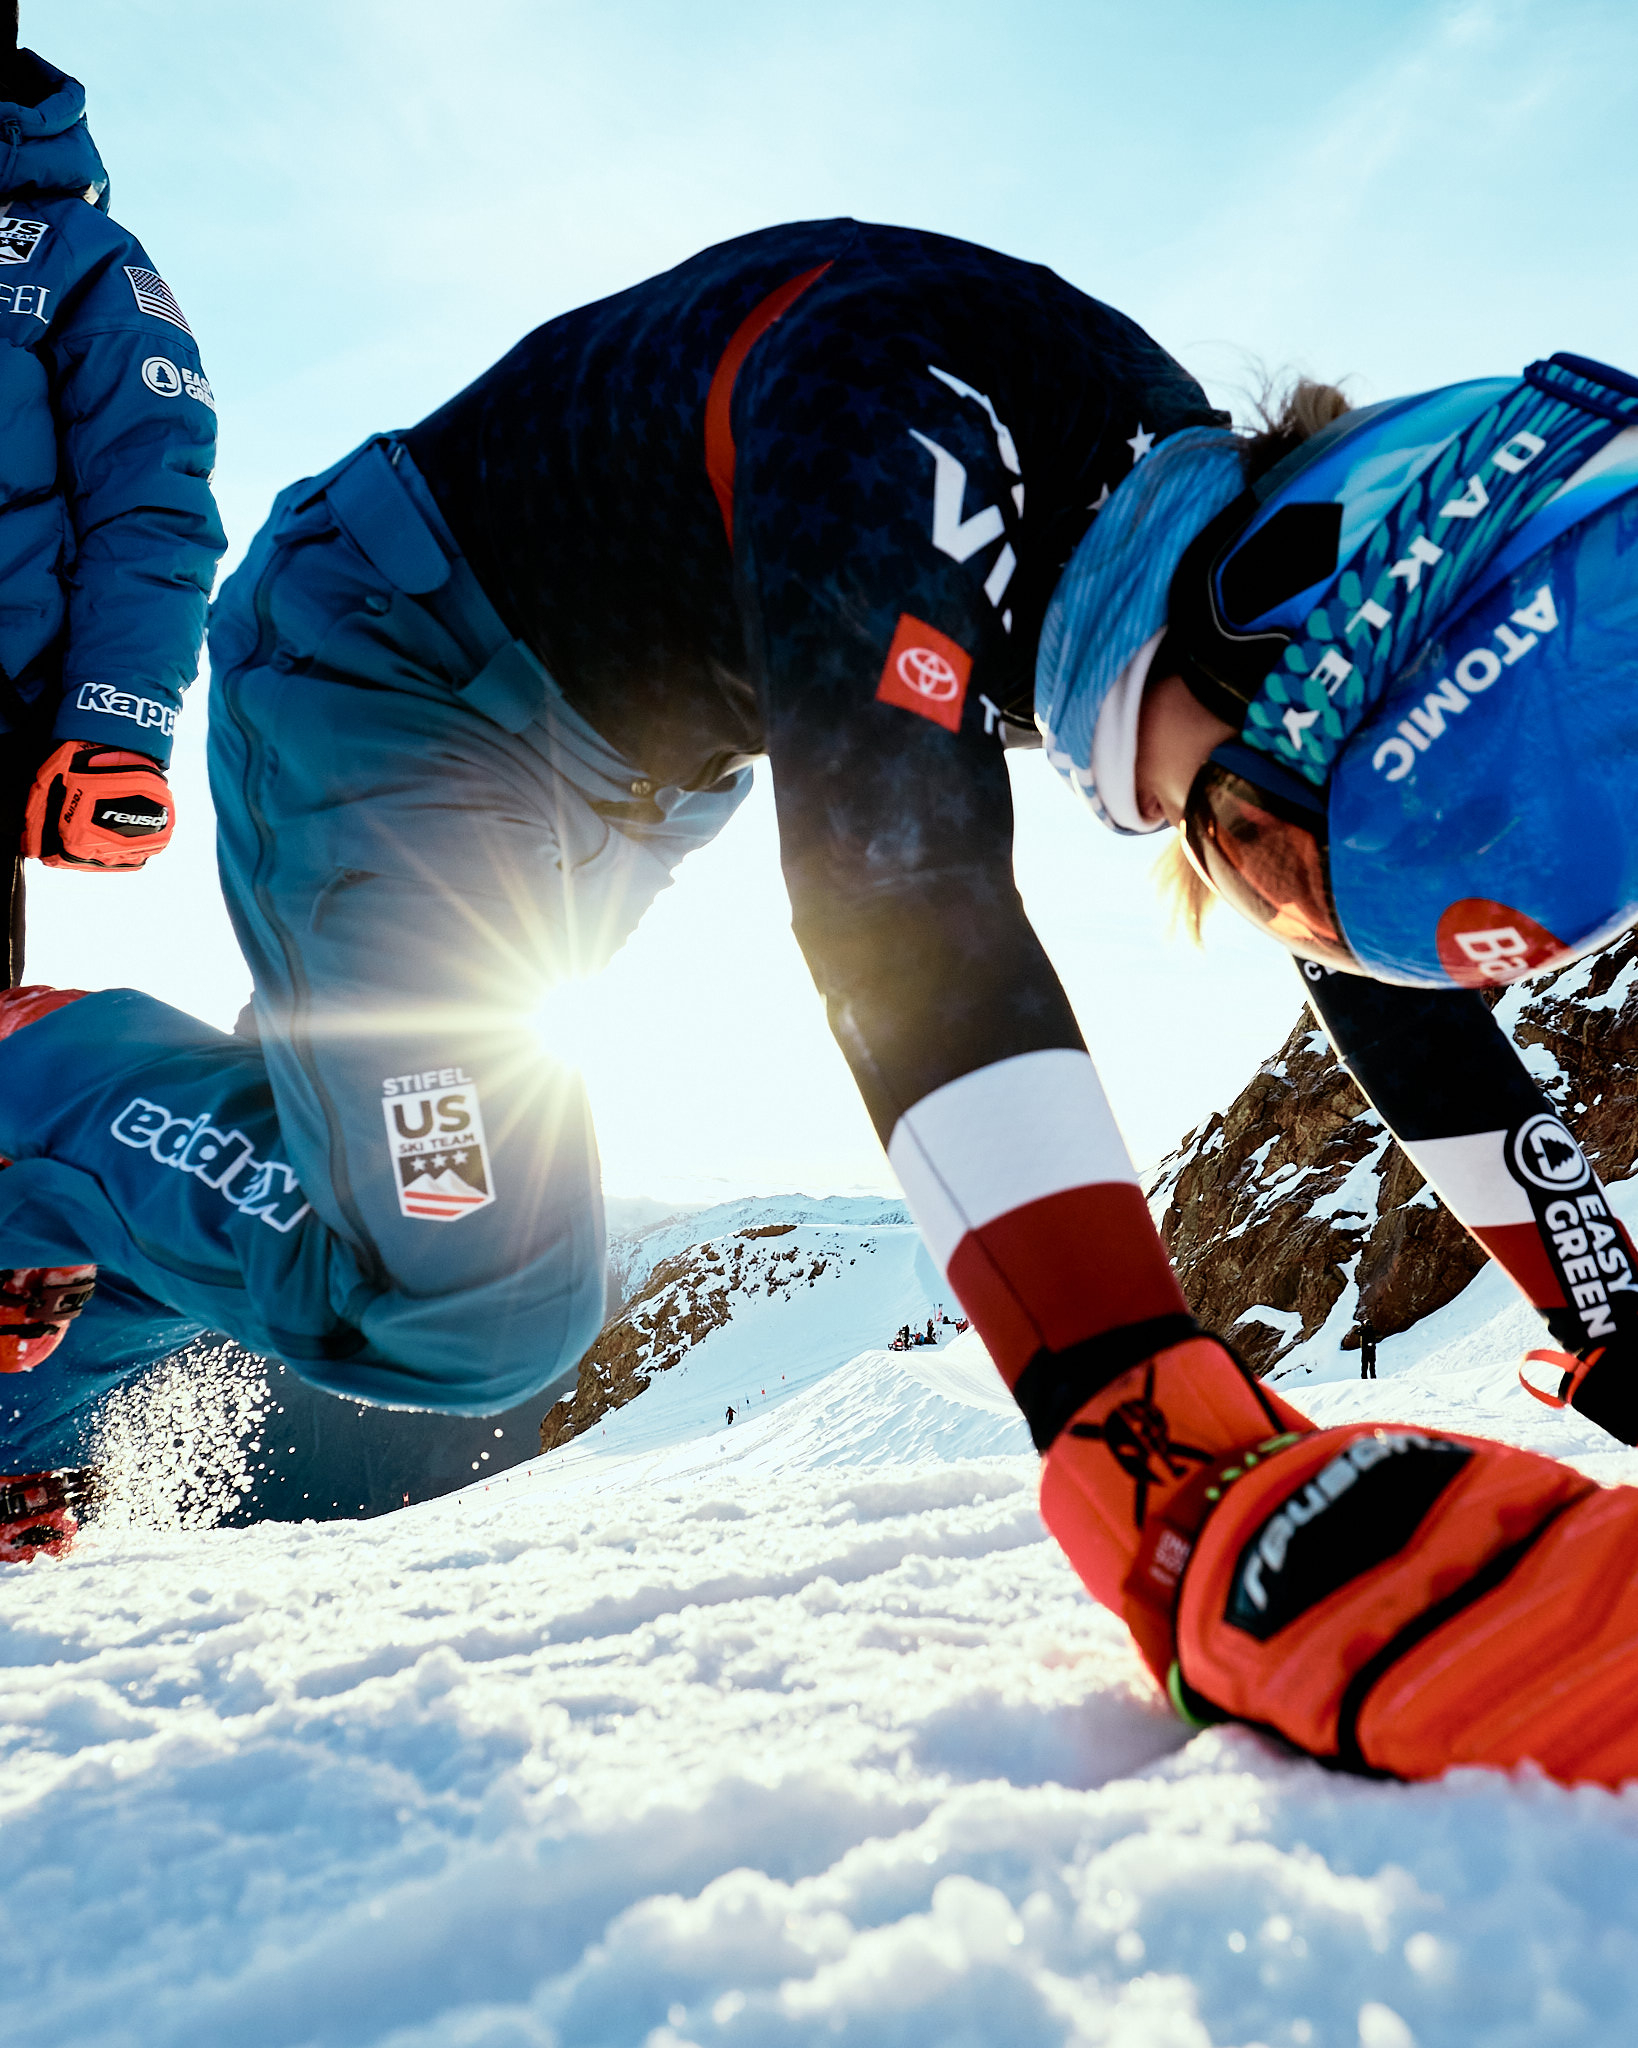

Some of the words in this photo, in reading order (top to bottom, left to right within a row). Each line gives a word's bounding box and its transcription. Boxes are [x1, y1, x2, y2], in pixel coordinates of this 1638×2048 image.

[1282, 431, 1546, 751] OAKLEY
[1373, 585, 1559, 781] ATOMIC
[64, 788, 83, 824] racing
[101, 807, 168, 827] reusch
[382, 1067, 472, 1096] STIFEL
[393, 1094, 471, 1139] US
[111, 1098, 311, 1233] Kappa
[399, 1143, 424, 1154] SKI
[430, 1133, 475, 1149] TEAM
[1545, 1200, 1617, 1339] GREEN
[1576, 1194, 1638, 1292] EASY
[1243, 1432, 1432, 1611] reusch
